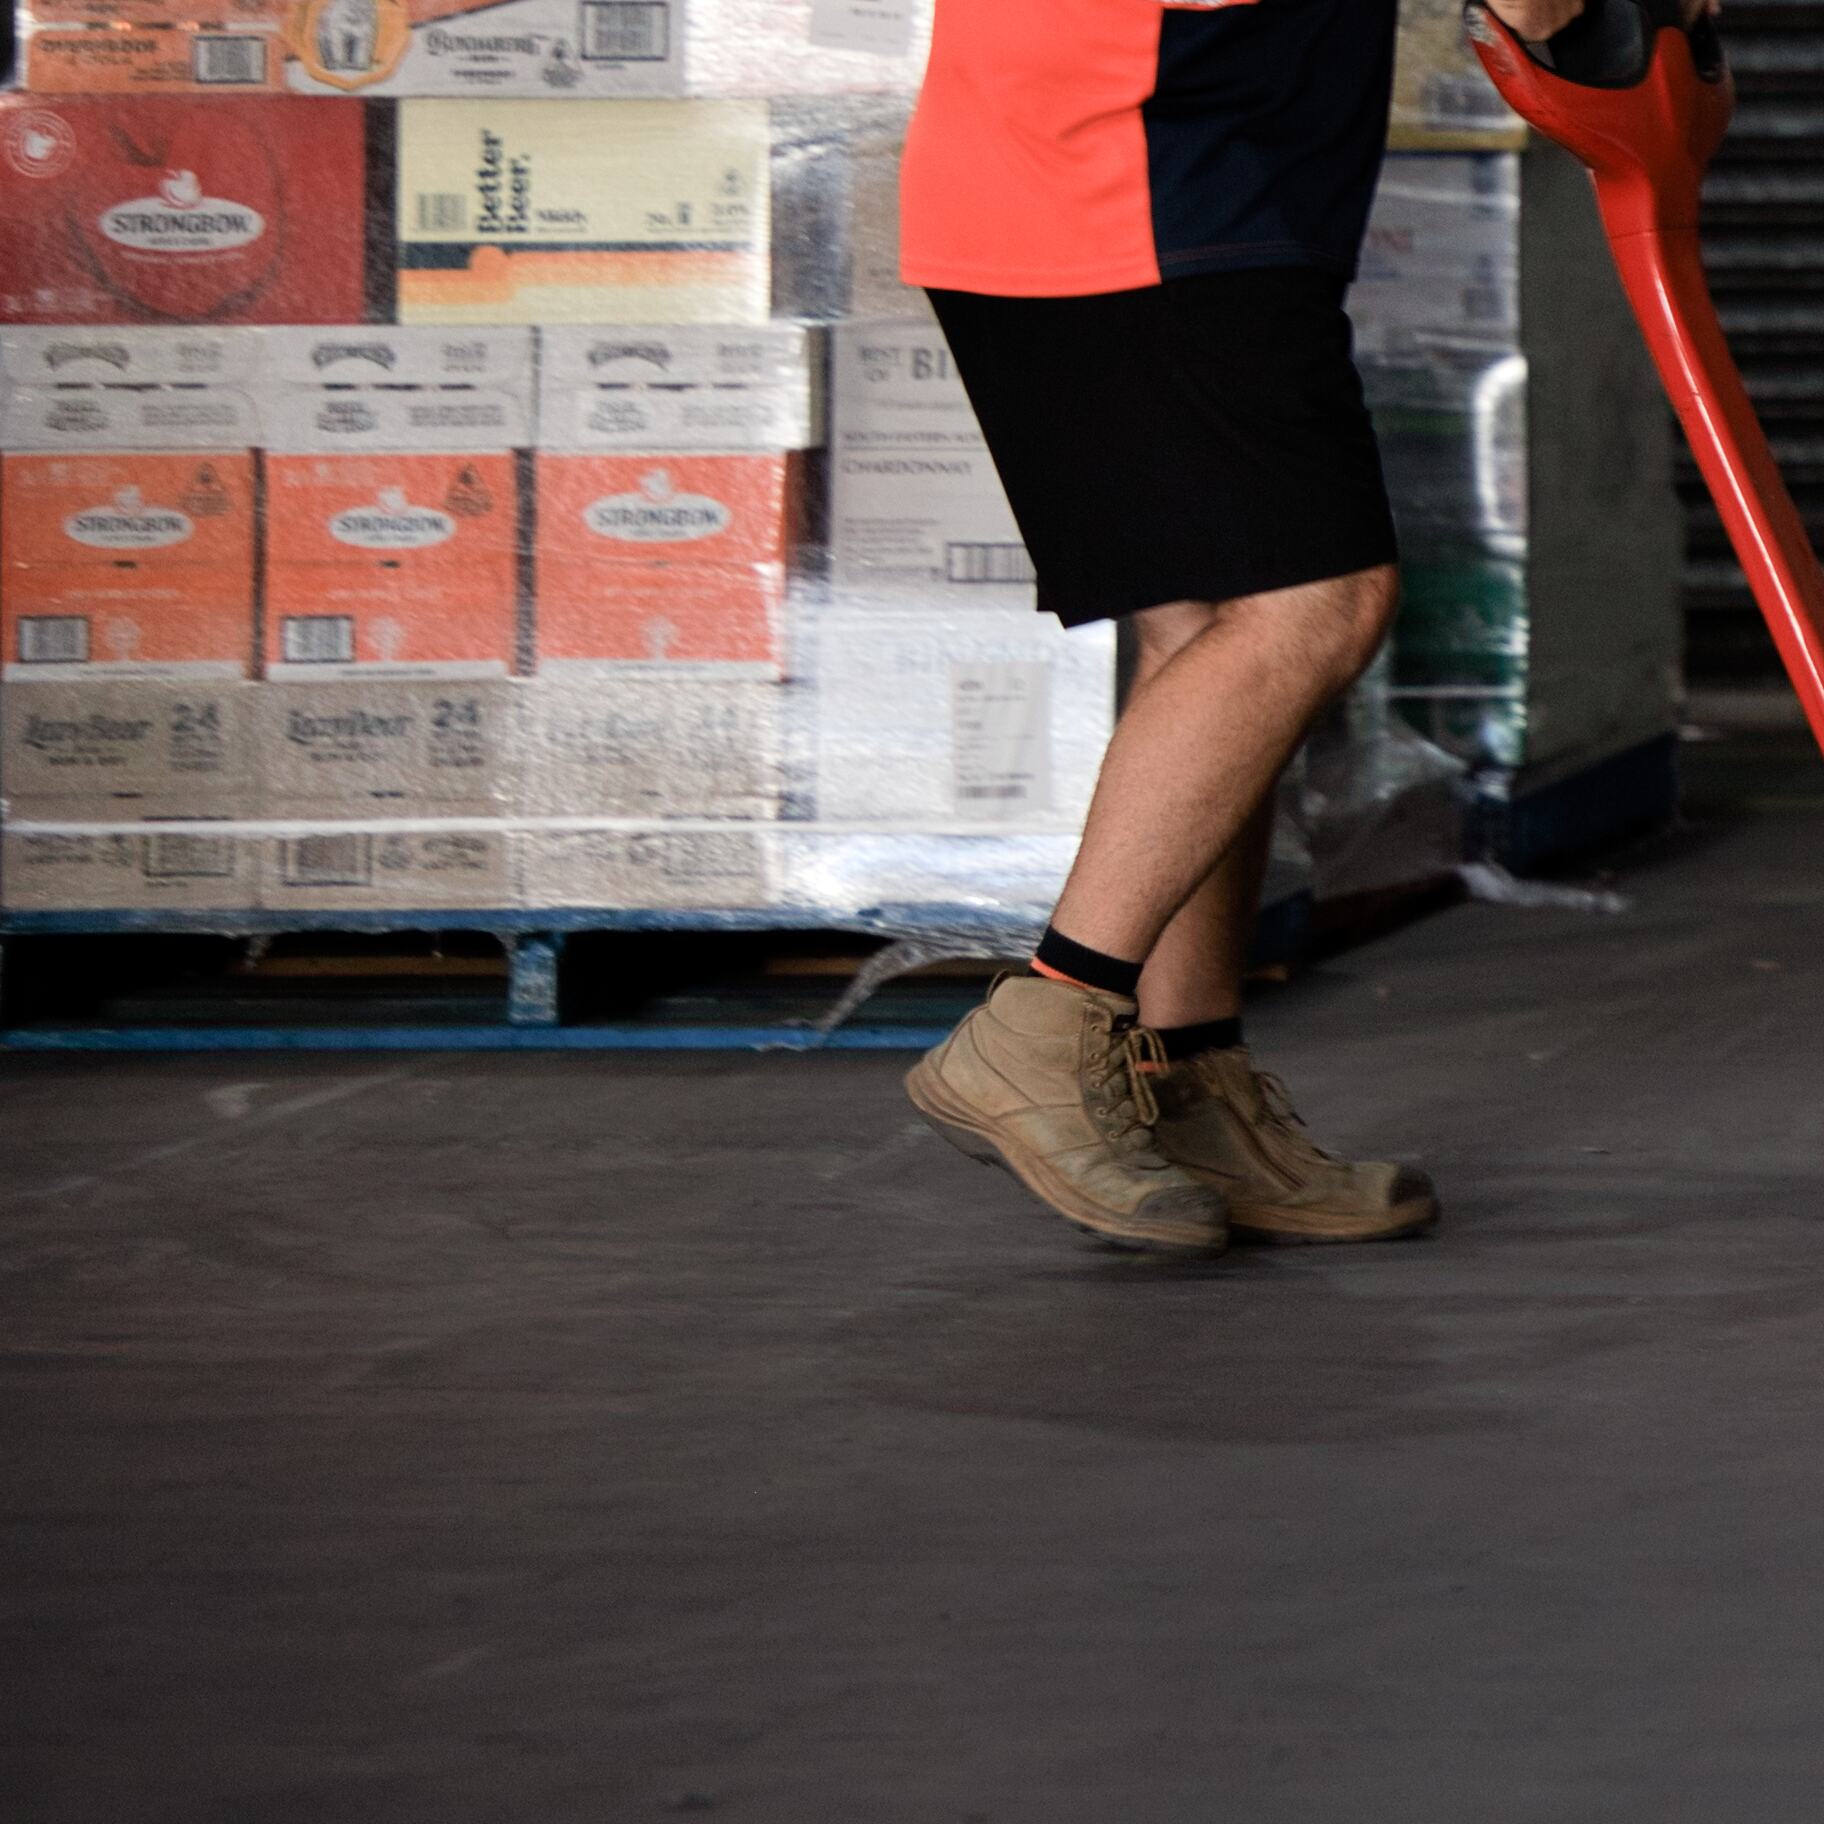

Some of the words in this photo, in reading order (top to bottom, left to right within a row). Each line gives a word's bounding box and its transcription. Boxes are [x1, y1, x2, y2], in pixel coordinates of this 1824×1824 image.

[111, 213, 253, 234] STRONGBOW
[76, 516, 184, 533] STRONGBOW
[339, 516, 446, 533] STRONGBOW
[596, 507, 721, 527] STRONGBOW
